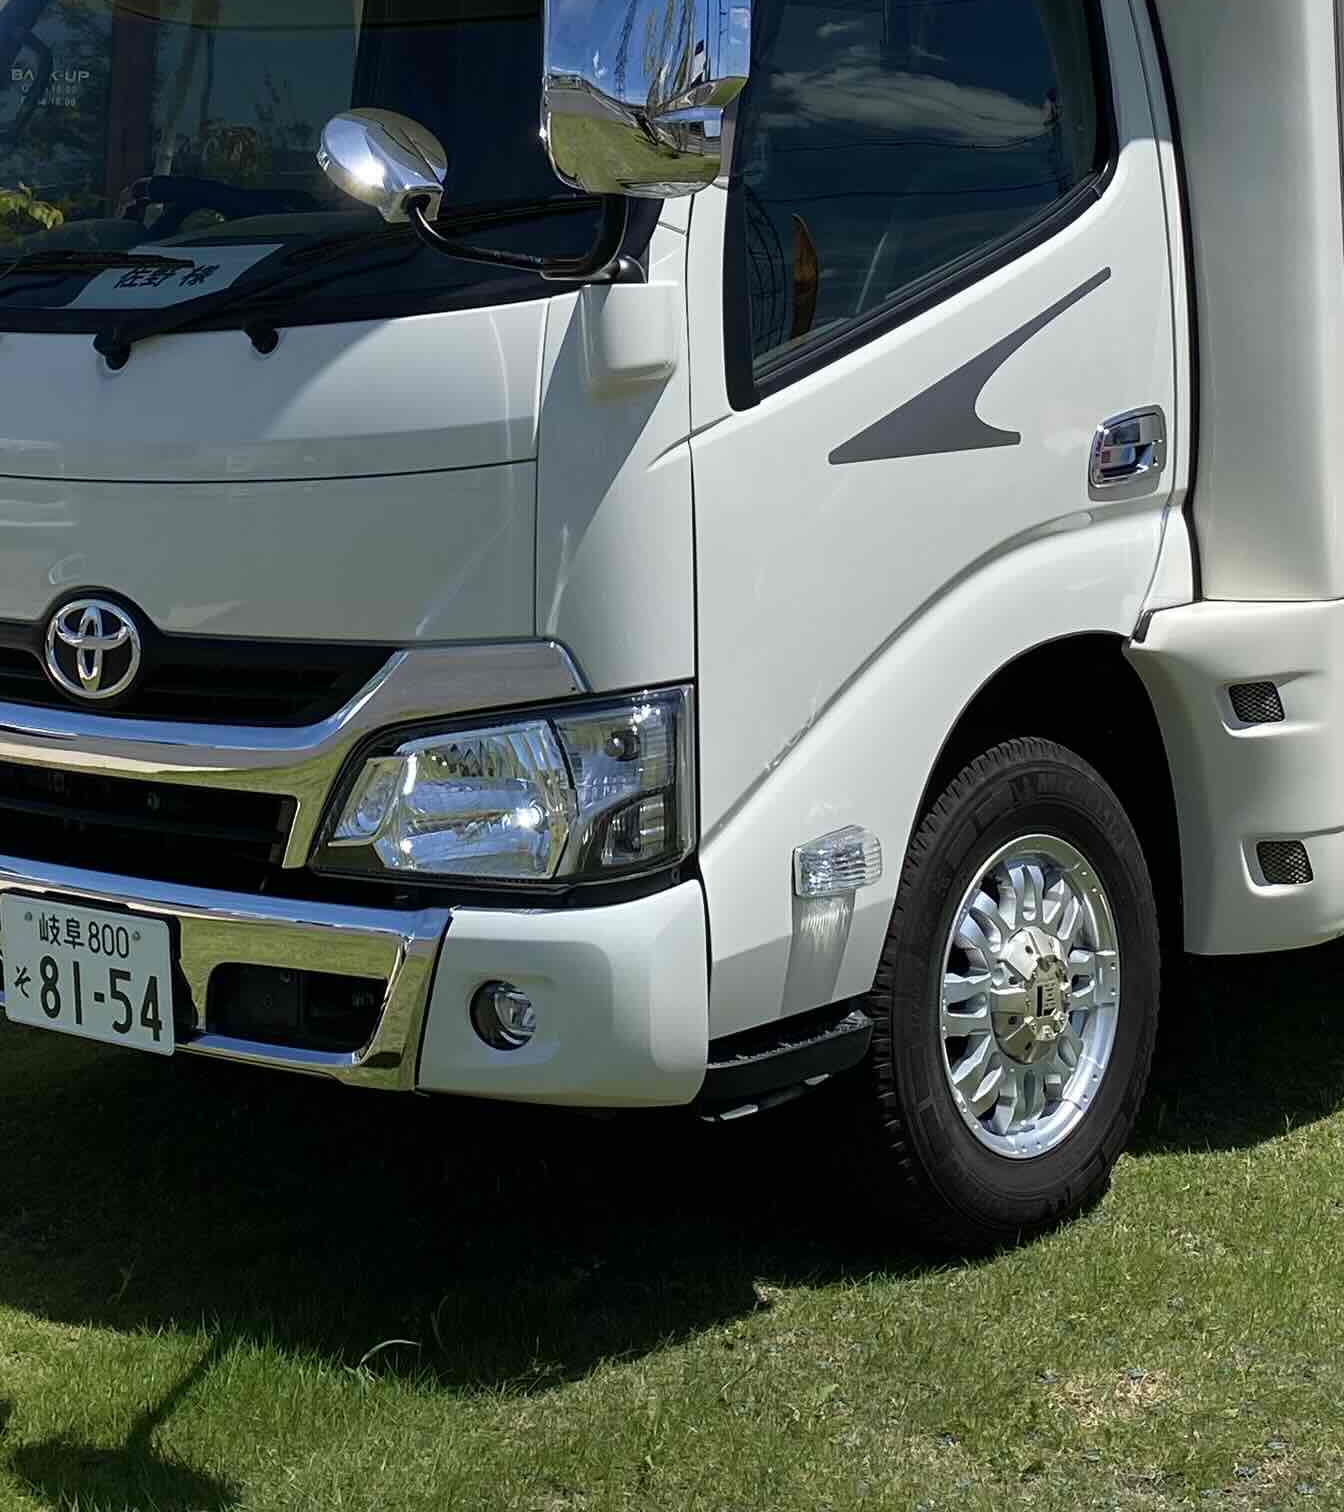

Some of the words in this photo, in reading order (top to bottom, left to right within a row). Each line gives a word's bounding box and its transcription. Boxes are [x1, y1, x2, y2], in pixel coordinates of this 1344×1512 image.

[11, 68, 90, 83] BAK-UP
[13, 965, 32, 999] そ
[39, 954, 163, 1042] 81-54
